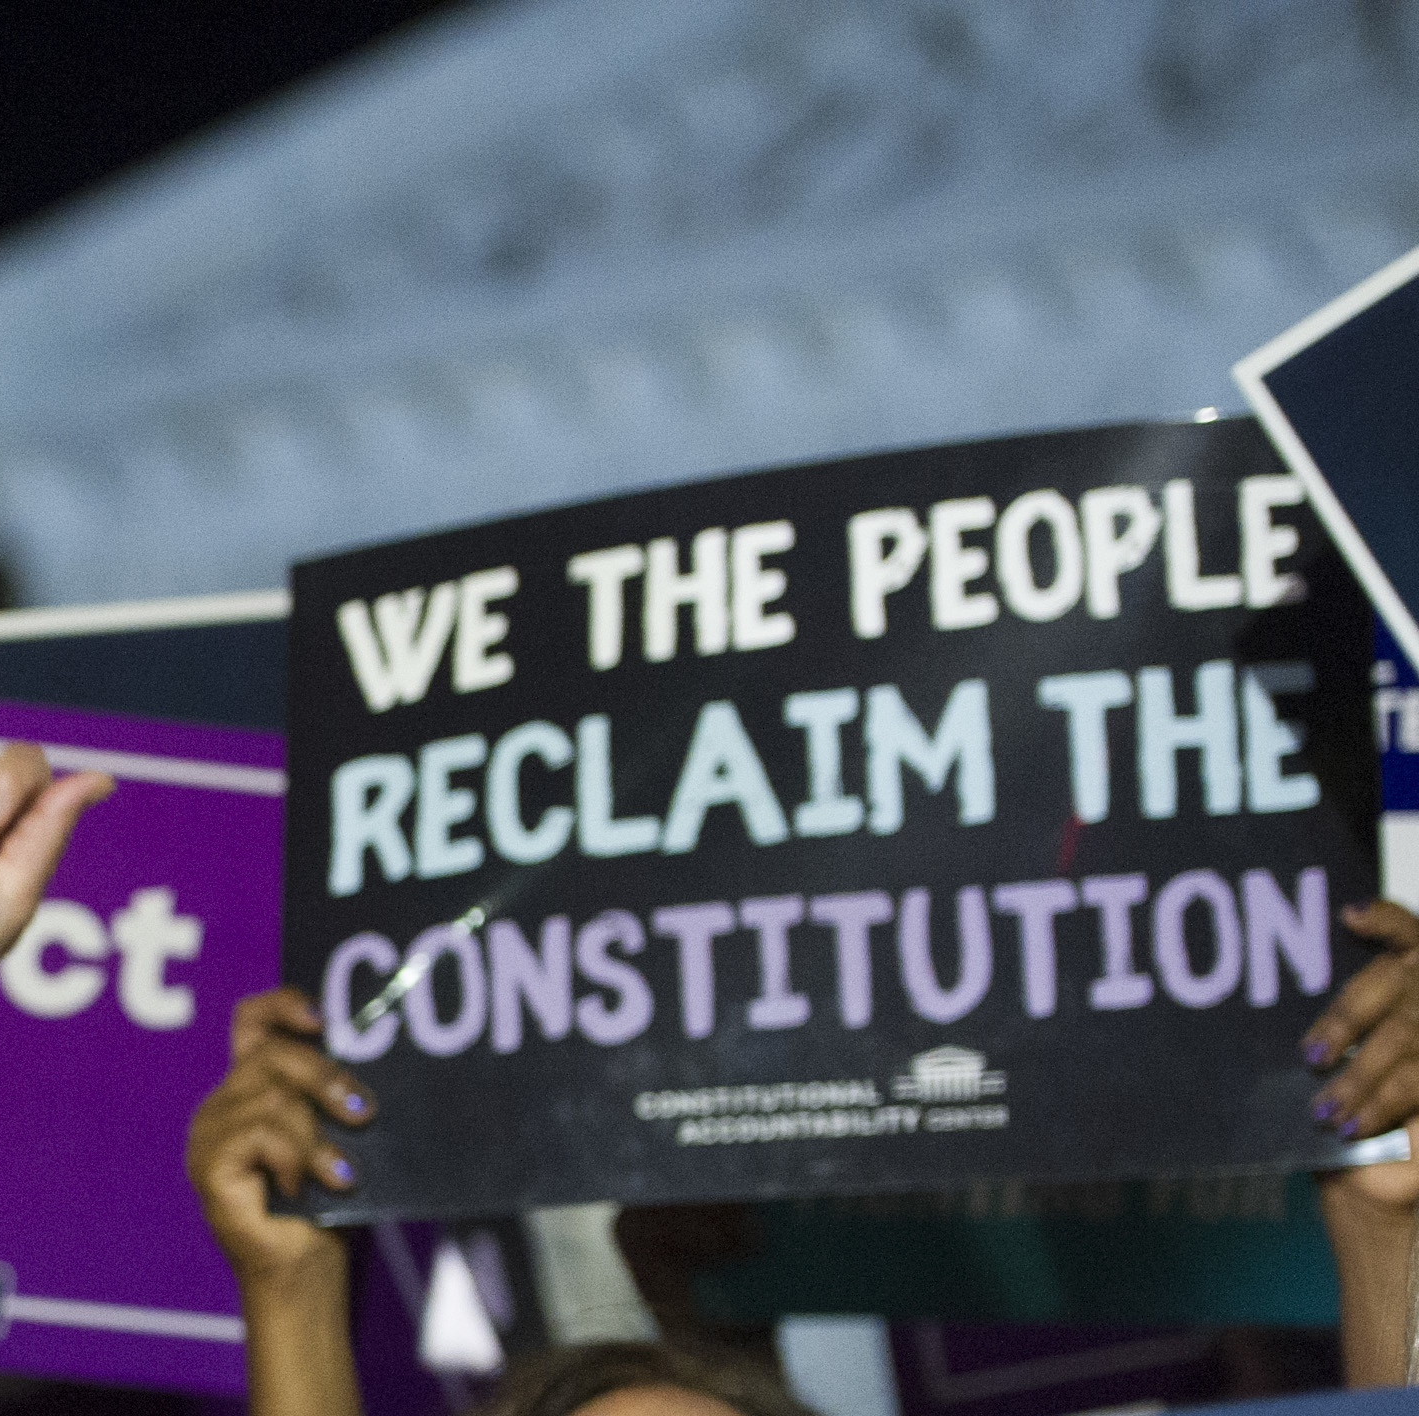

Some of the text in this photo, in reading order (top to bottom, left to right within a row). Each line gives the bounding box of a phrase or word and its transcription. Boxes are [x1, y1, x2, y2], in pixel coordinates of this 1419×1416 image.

[337, 472, 1308, 712] WE THE PEOPLE
[326, 678, 995, 897] RECLAIM
[1040, 660, 1320, 824] THE
[322, 866, 1333, 1064] CONSTITUTION
